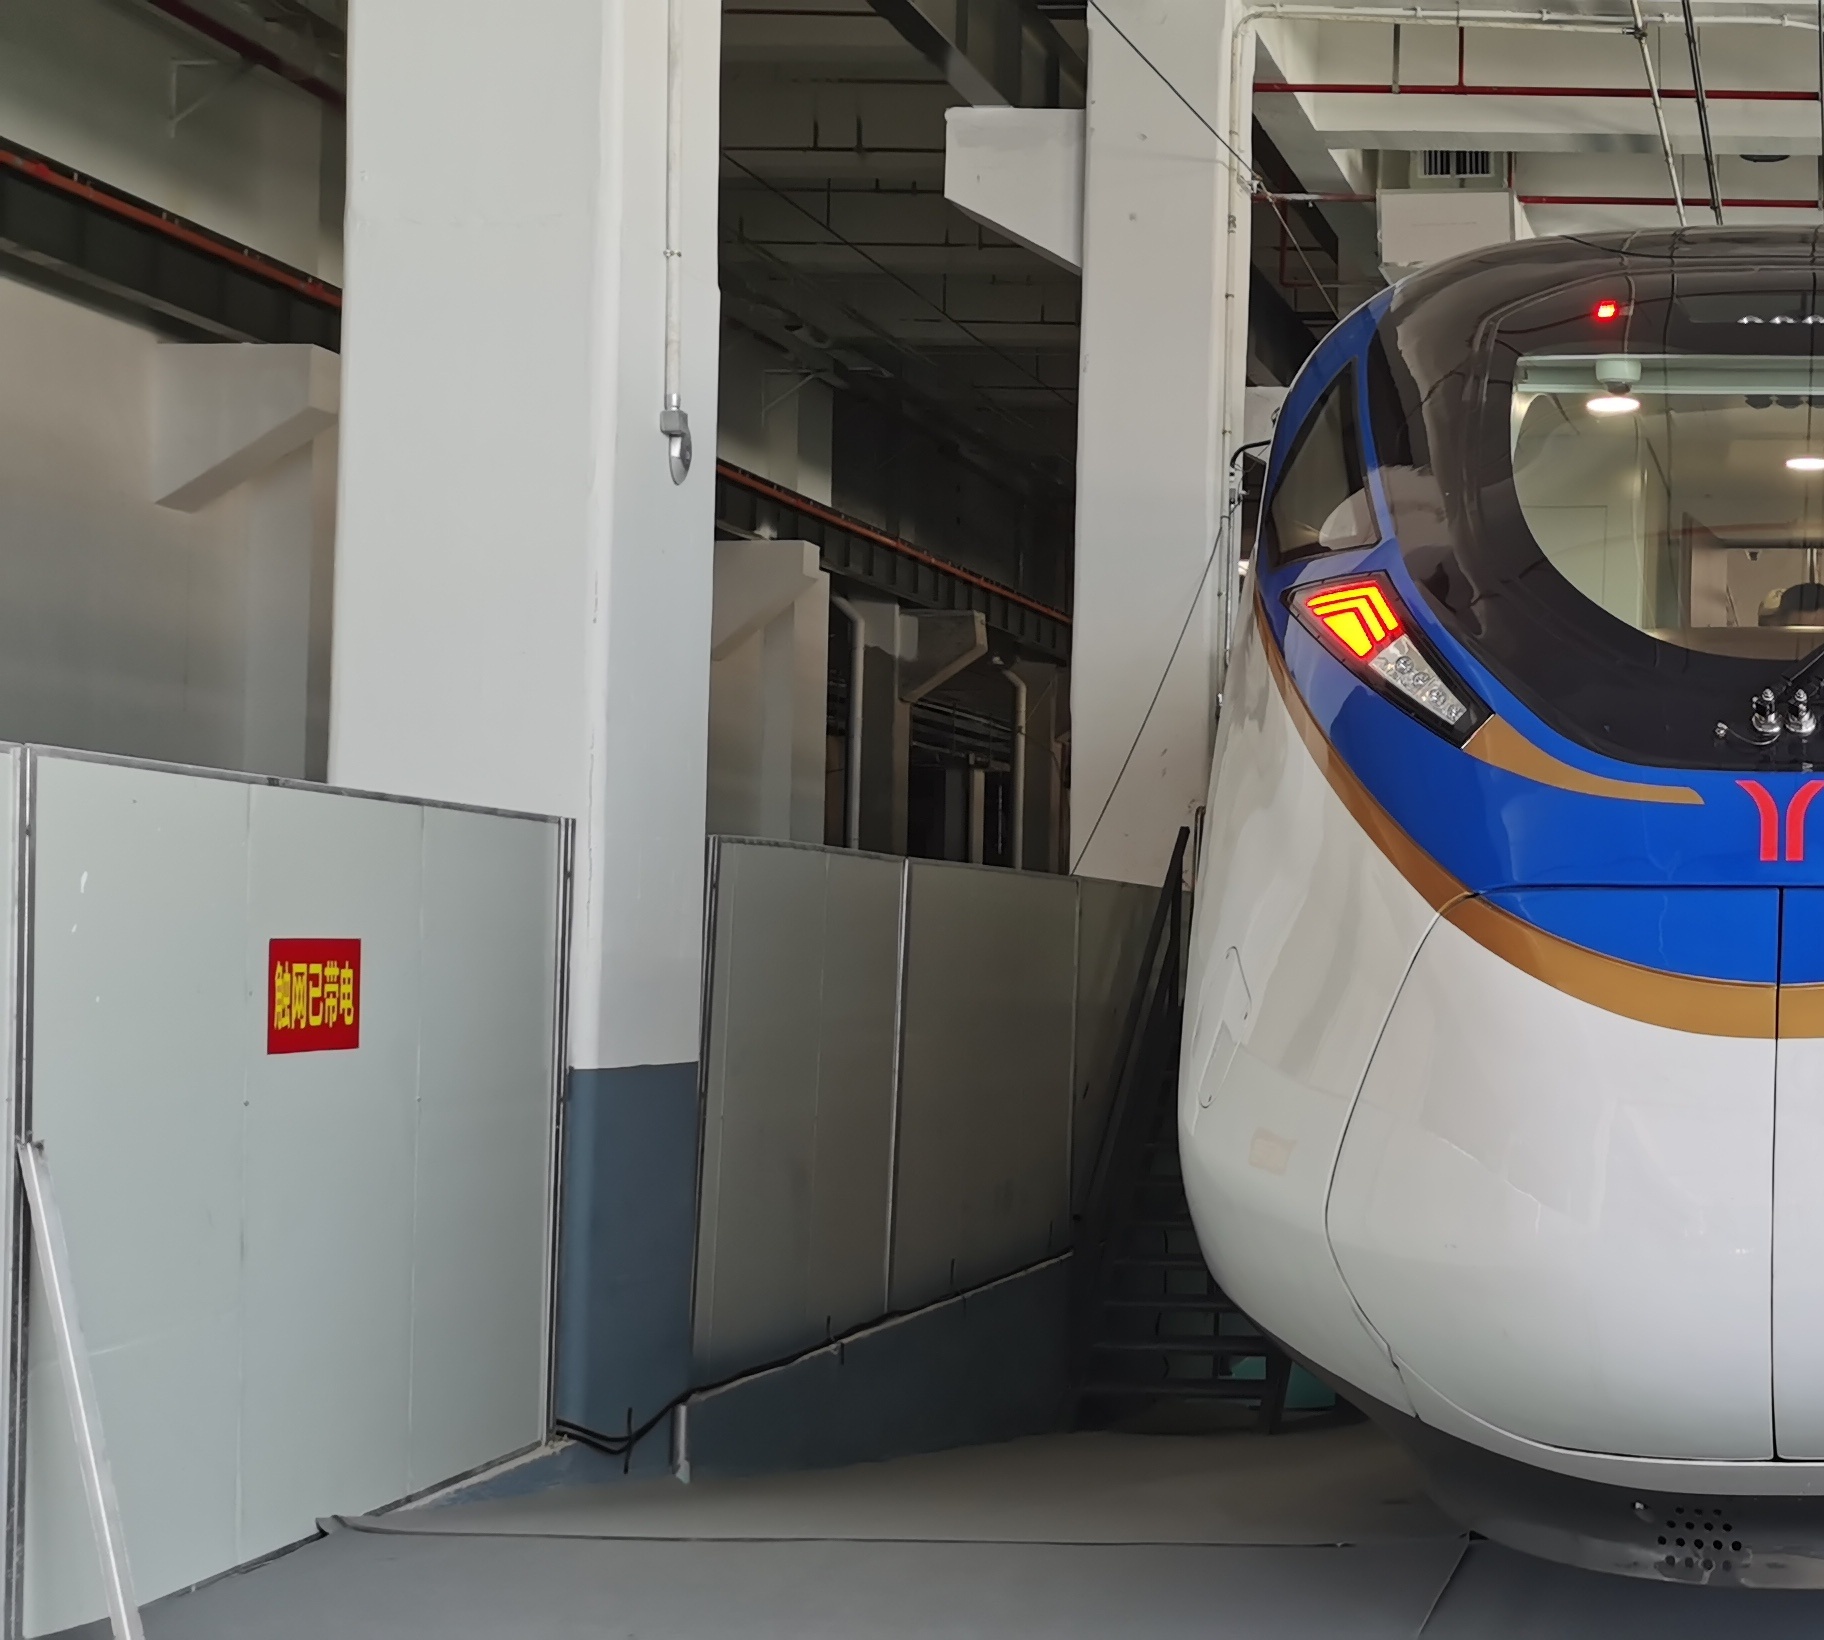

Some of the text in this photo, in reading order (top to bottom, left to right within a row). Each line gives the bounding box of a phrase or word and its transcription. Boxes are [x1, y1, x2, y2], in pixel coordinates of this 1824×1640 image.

[274, 960, 354, 1029] 触网已带电
